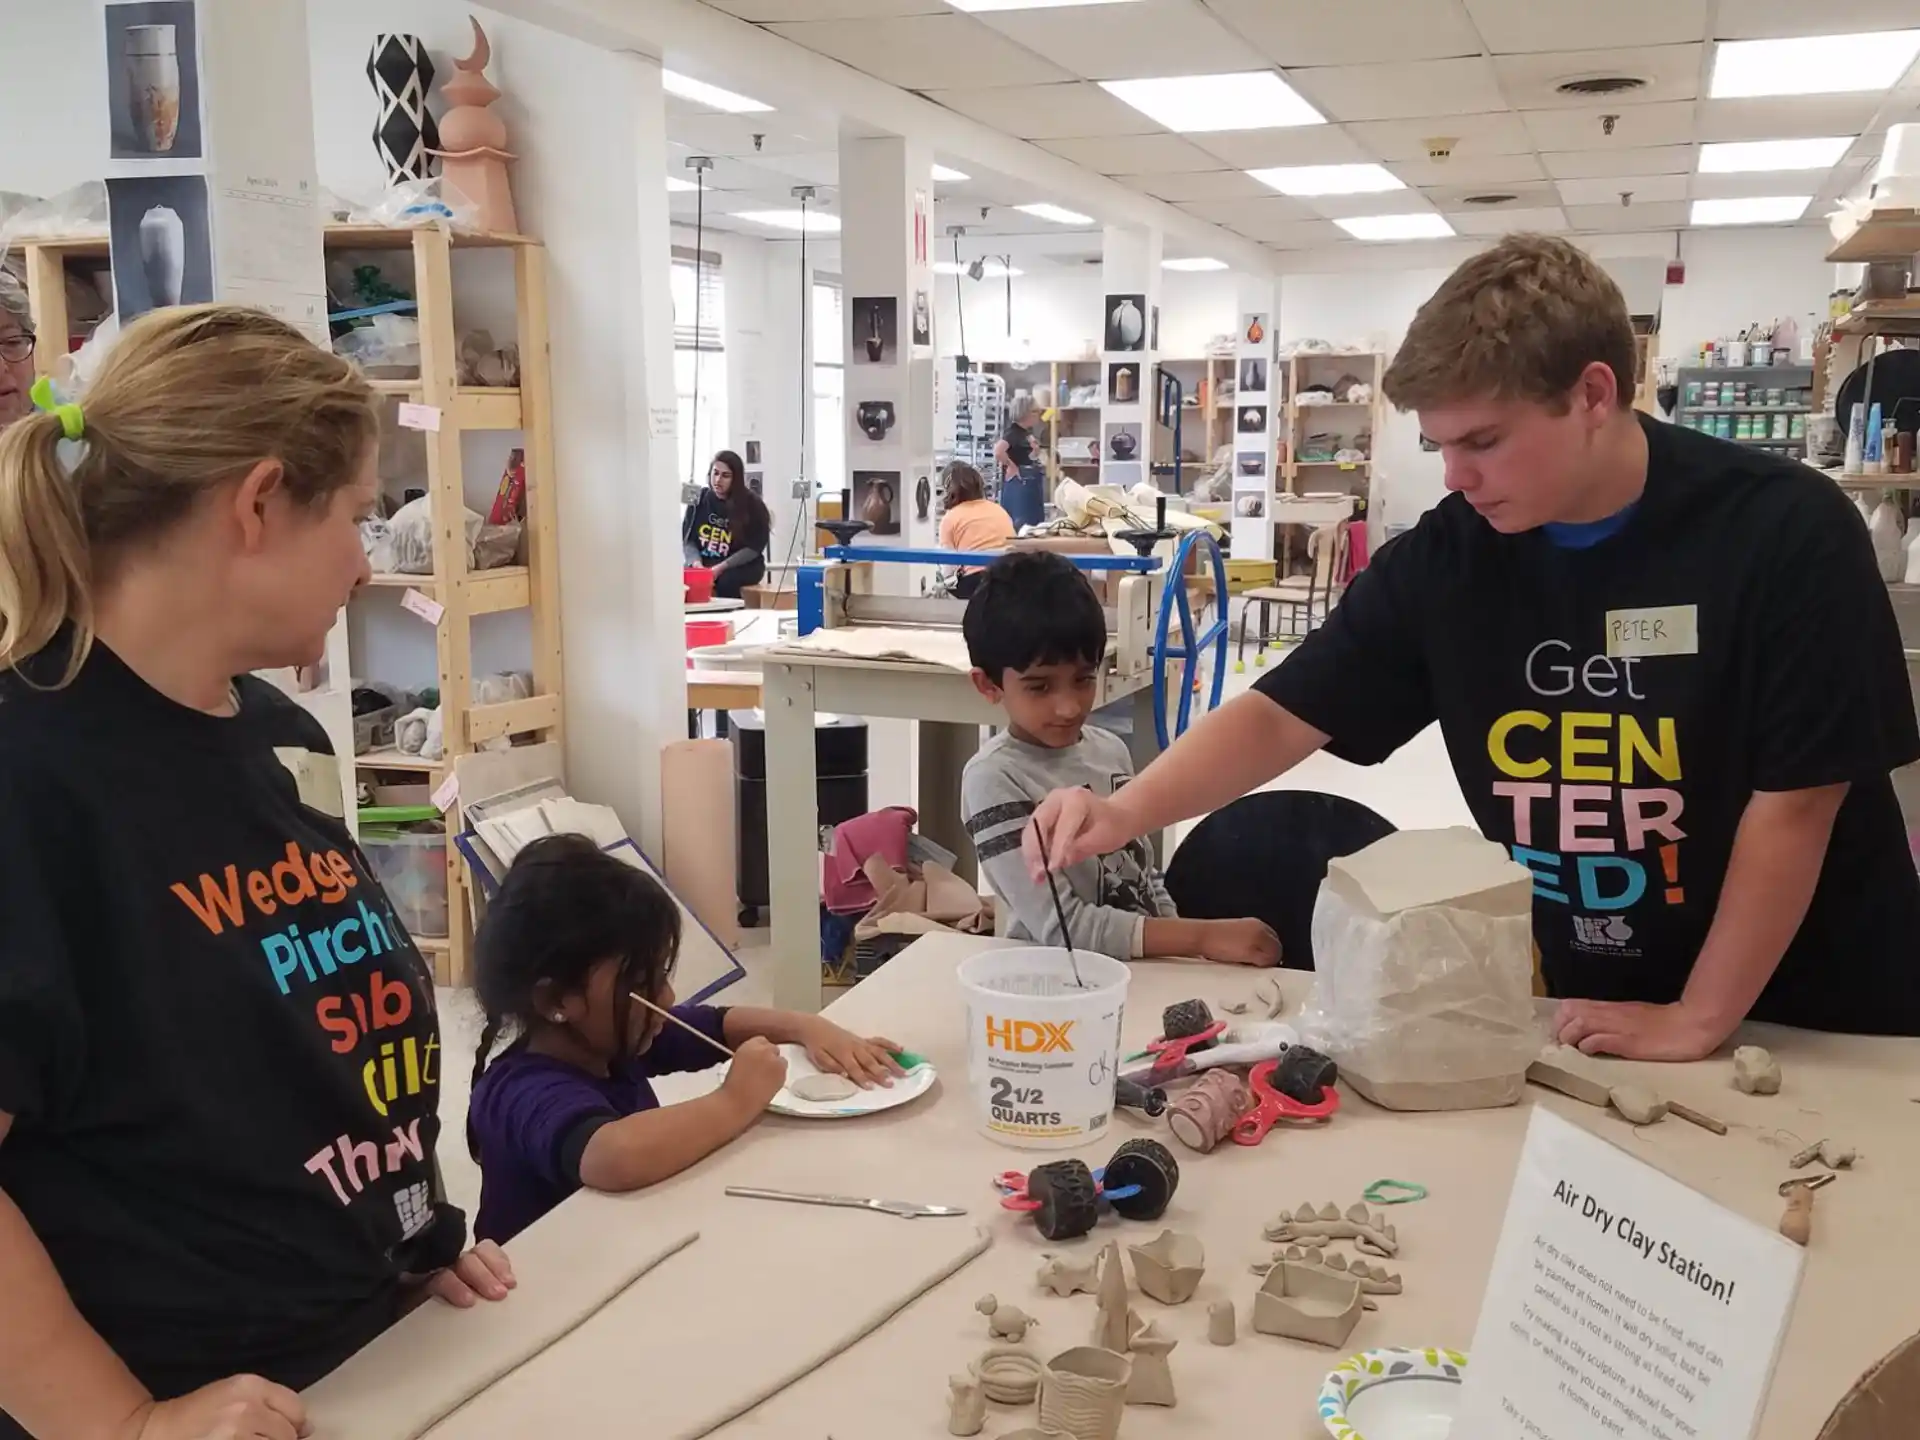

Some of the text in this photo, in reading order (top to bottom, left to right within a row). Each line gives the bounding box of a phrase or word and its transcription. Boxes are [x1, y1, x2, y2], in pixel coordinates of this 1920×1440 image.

[698, 537, 729, 557] TER
[699, 524, 732, 544] CEN
[708, 513, 729, 527] Get
[1611, 619, 1668, 641] PETER
[1525, 639, 1645, 700] Get
[1487, 709, 1683, 784] CEN
[1492, 781, 1688, 852] TER
[169, 841, 358, 936] Wedge
[986, 1015, 1075, 1053] HDX
[991, 1106, 1061, 1125] QUARTS
[1553, 1179, 1735, 1306] Air Dry Clay Station!
[1534, 1235, 1547, 1248] Air
[1547, 1245, 1560, 1260] dry
[1561, 1255, 1576, 1270] clay
[1578, 1265, 1597, 1284] does
[1599, 1279, 1613, 1294] not
[1615, 1290, 1636, 1310] need
[1637, 1304, 1647, 1317] to
[1648, 1309, 1660, 1324] be
[1687, 1341, 1705, 1356] and
[1706, 1351, 1724, 1369] can
[1546, 1268, 1576, 1293] painted
[1576, 1289, 1586, 1301] at
[1623, 1320, 1639, 1335] will
[1640, 1333, 1655, 1349] dry
[1681, 1357, 1697, 1377] but
[1698, 1368, 1711, 1387] be
[1535, 1285, 1562, 1307] careful
[1561, 1305, 1570, 1315] as
[1588, 1321, 1602, 1337] not
[1602, 1332, 1612, 1344] as
[1615, 1340, 1641, 1367] strong
[1642, 1362, 1652, 1373] as
[1654, 1365, 1676, 1388] fired
[1523, 1302, 1535, 1320] Try
[1535, 1315, 1563, 1343] making
[1571, 1341, 1587, 1360] clay
[1638, 1387, 1661, 1410] bowl
[1661, 1404, 1676, 1420] for
[1676, 1417, 1698, 1437] your
[1532, 1338, 1543, 1348] or
[1544, 1346, 1578, 1376] whatever
[1581, 1372, 1596, 1390] you
[1597, 1387, 1612, 1401] can
[1567, 1385, 1590, 1412] home
[1591, 1405, 1601, 1419] to
